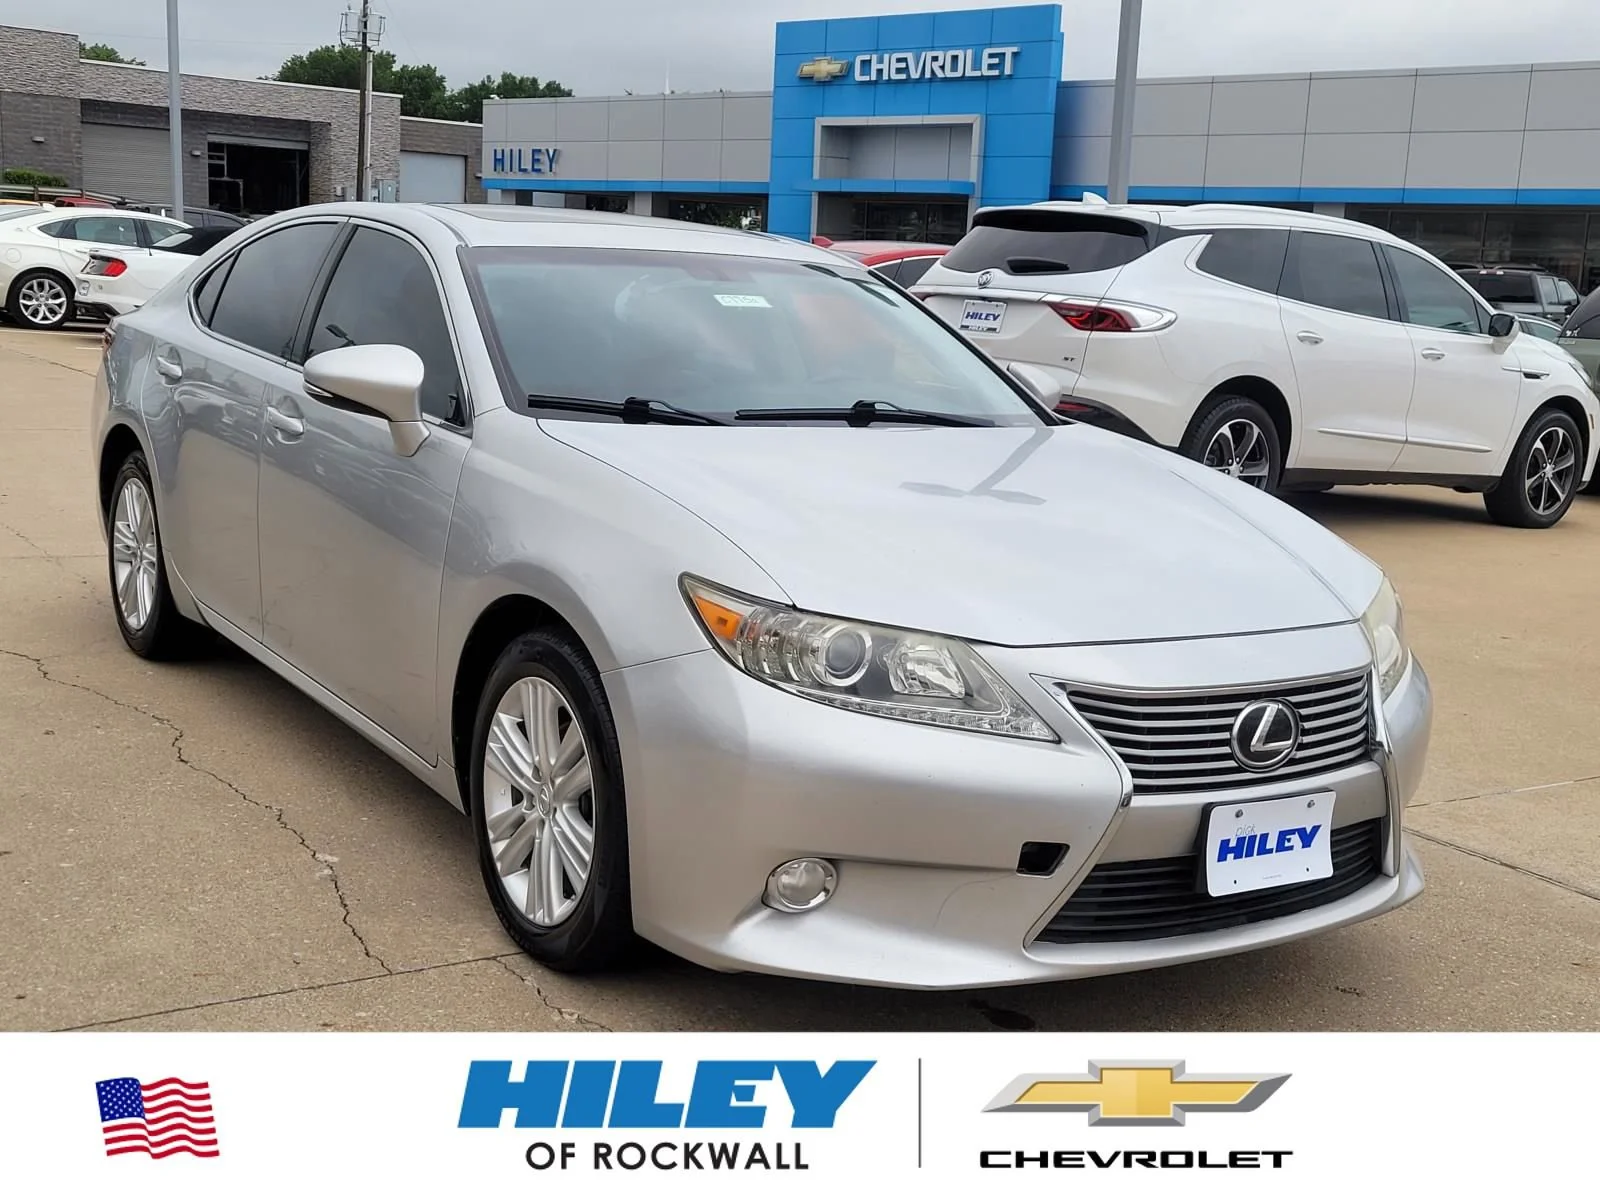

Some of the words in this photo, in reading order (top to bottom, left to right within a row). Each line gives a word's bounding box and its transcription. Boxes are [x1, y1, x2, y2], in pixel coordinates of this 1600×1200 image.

[854, 46, 1020, 82] CHEVROLET
[493, 148, 560, 173] HILEY
[964, 311, 1001, 321] HILEY
[1216, 824, 1323, 863] HILEY
